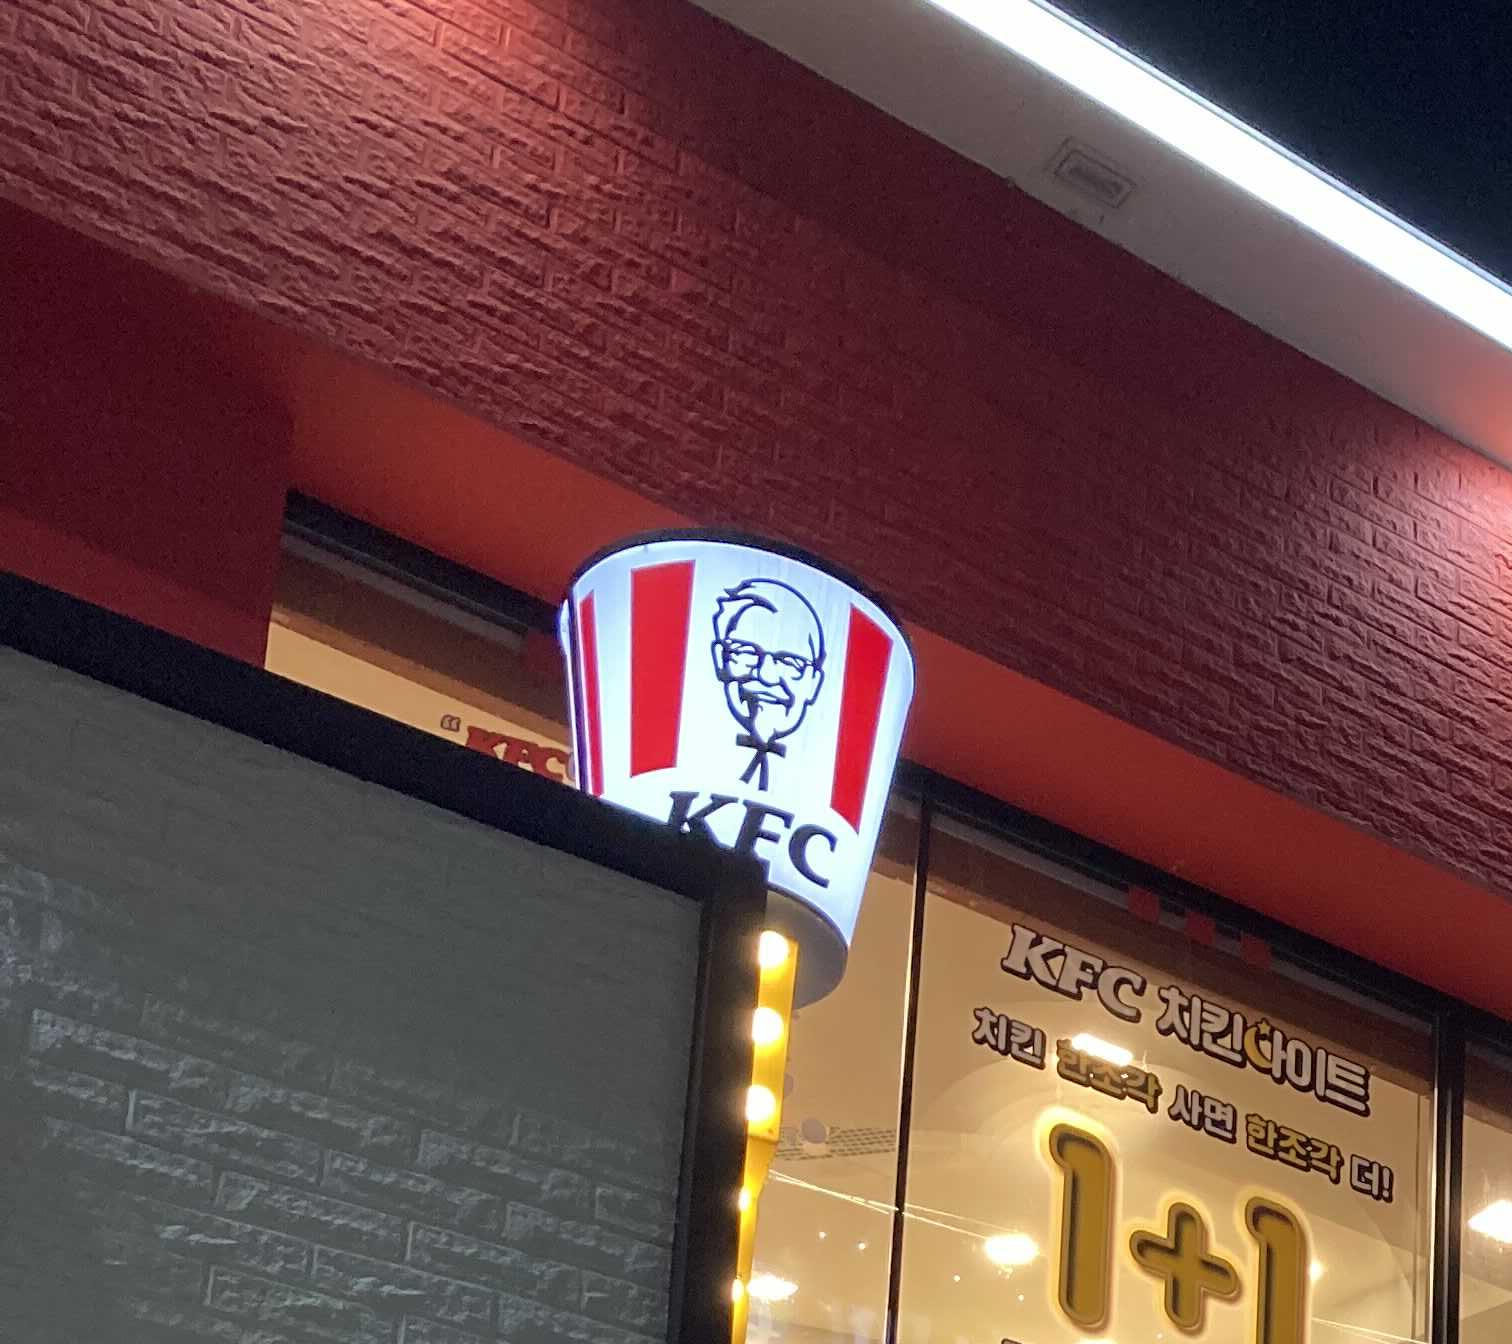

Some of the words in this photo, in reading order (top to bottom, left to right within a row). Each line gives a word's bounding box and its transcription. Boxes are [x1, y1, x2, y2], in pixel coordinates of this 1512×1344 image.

[666, 789, 839, 889] KFC
[972, 1006, 1046, 1071] 치킨
[1056, 1037, 1164, 1114] 한조각
[1168, 1082, 1237, 1145] 사면
[1245, 1112, 1344, 1184] 한조각
[1349, 1155, 1395, 1204] 더!
[1001, 924, 1146, 1024] KFC
[1158, 984, 1373, 1118] 치킨나이트
